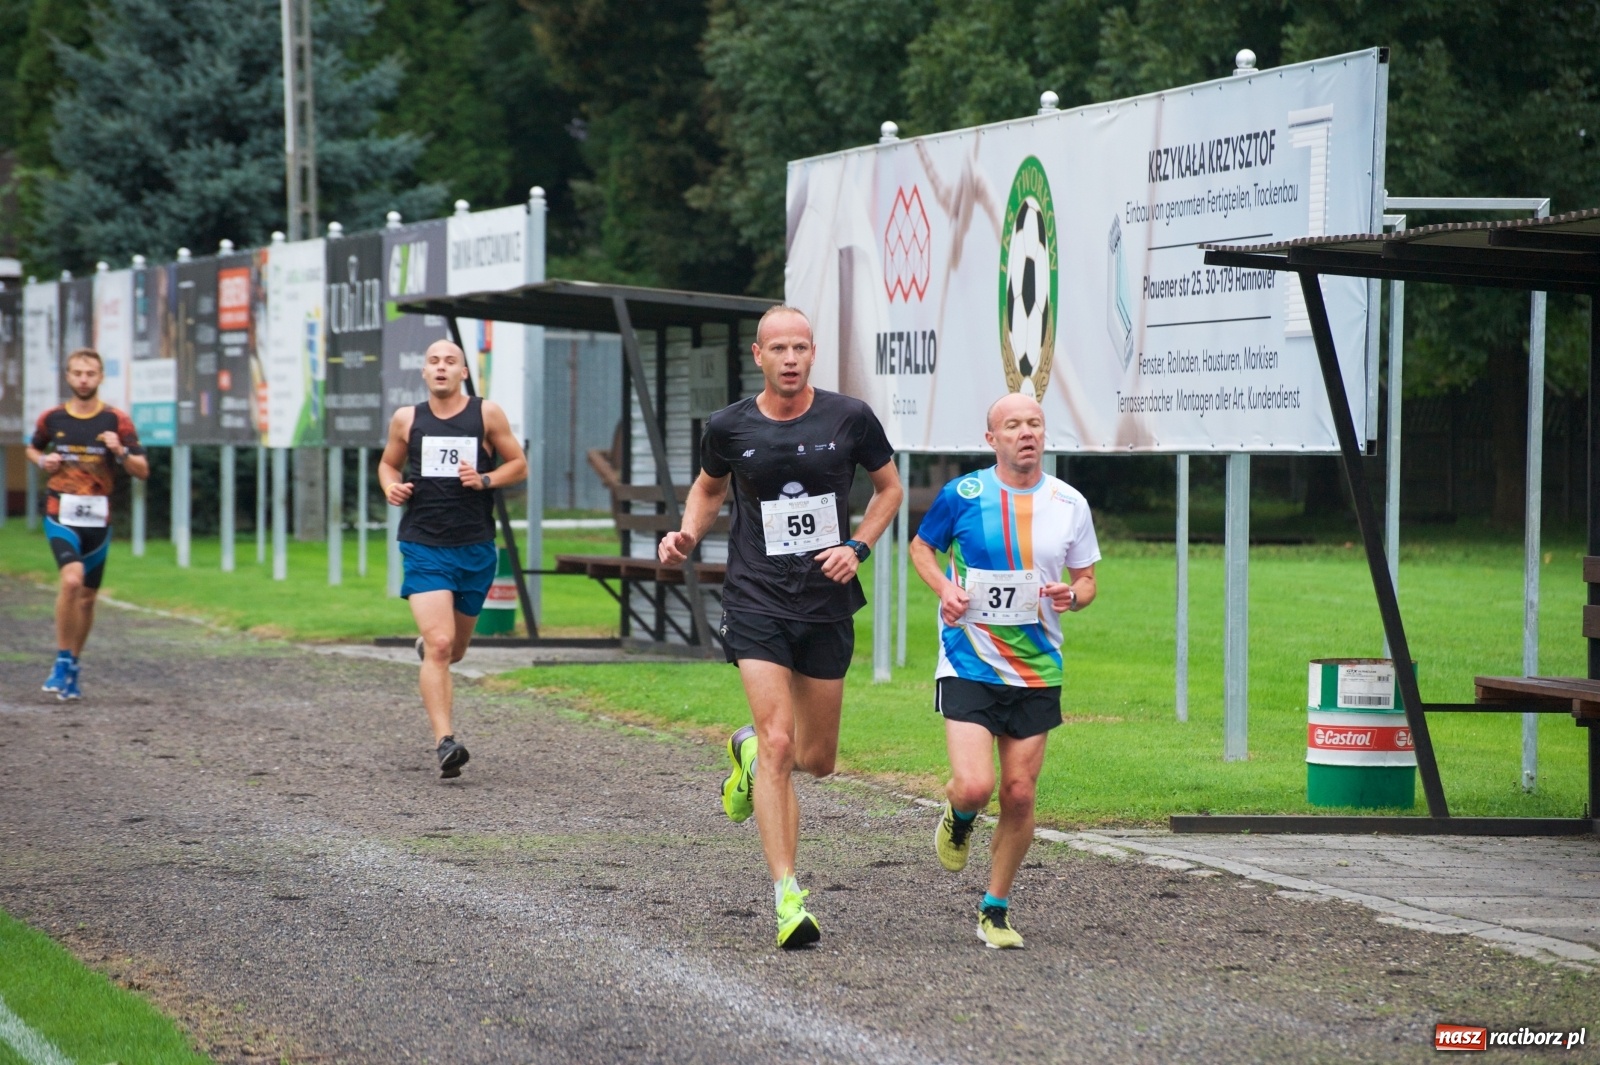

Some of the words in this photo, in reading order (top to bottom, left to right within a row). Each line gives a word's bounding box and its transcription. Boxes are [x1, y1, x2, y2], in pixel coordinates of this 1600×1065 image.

[1148, 143, 1206, 183] KRZYKAŁA
[1208, 129, 1276, 174] KRZYSZTOF
[1126, 200, 1150, 224] Einbau
[1152, 203, 1164, 220] von
[1165, 194, 1205, 226] genormten
[1207, 185, 1251, 218] Fertigteilen,
[1253, 179, 1299, 207] Trockenbau
[1143, 274, 1177, 300] Plauener
[1178, 274, 1190, 296] str
[1191, 270, 1204, 295] 25.
[1205, 266, 1234, 295] 30-179
[1235, 266, 1277, 291] Hannover
[875, 329, 937, 375] METALIO
[1138, 353, 1166, 377] Fenster,
[1167, 350, 1200, 375] Rolladen,
[1202, 349, 1242, 374] Hausturen,
[1243, 345, 1279, 370] Markisen
[1175, 388, 1214, 418] Montagen
[1215, 386, 1231, 410] aller
[1232, 386, 1246, 413] Art,
[1247, 384, 1300, 410] Kundendienst
[439, 449, 459, 465] 78
[742, 449, 755, 458] 4F
[787, 513, 816, 537] 59
[988, 586, 1016, 609] 37
[1324, 730, 1372, 746] Castrol
